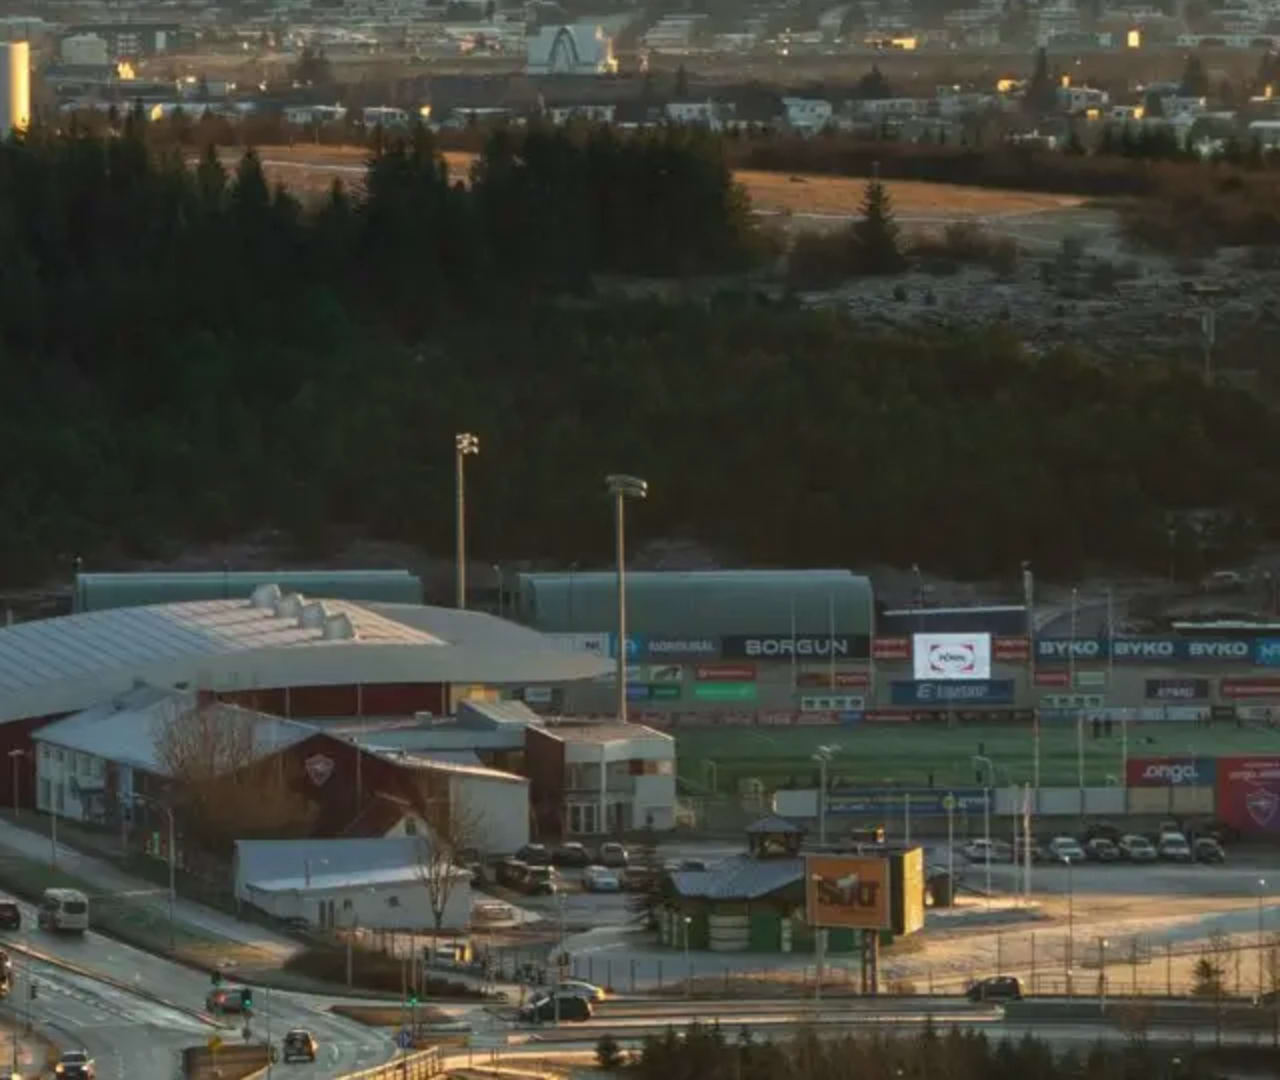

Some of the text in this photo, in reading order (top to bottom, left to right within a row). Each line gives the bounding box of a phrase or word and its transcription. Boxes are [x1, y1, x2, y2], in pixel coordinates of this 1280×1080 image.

[744, 639, 848, 655] BORGUN
[1039, 640, 1099, 655] BYKO
[1113, 640, 1174, 655] BYKO
[1188, 641, 1249, 655] BYKO
